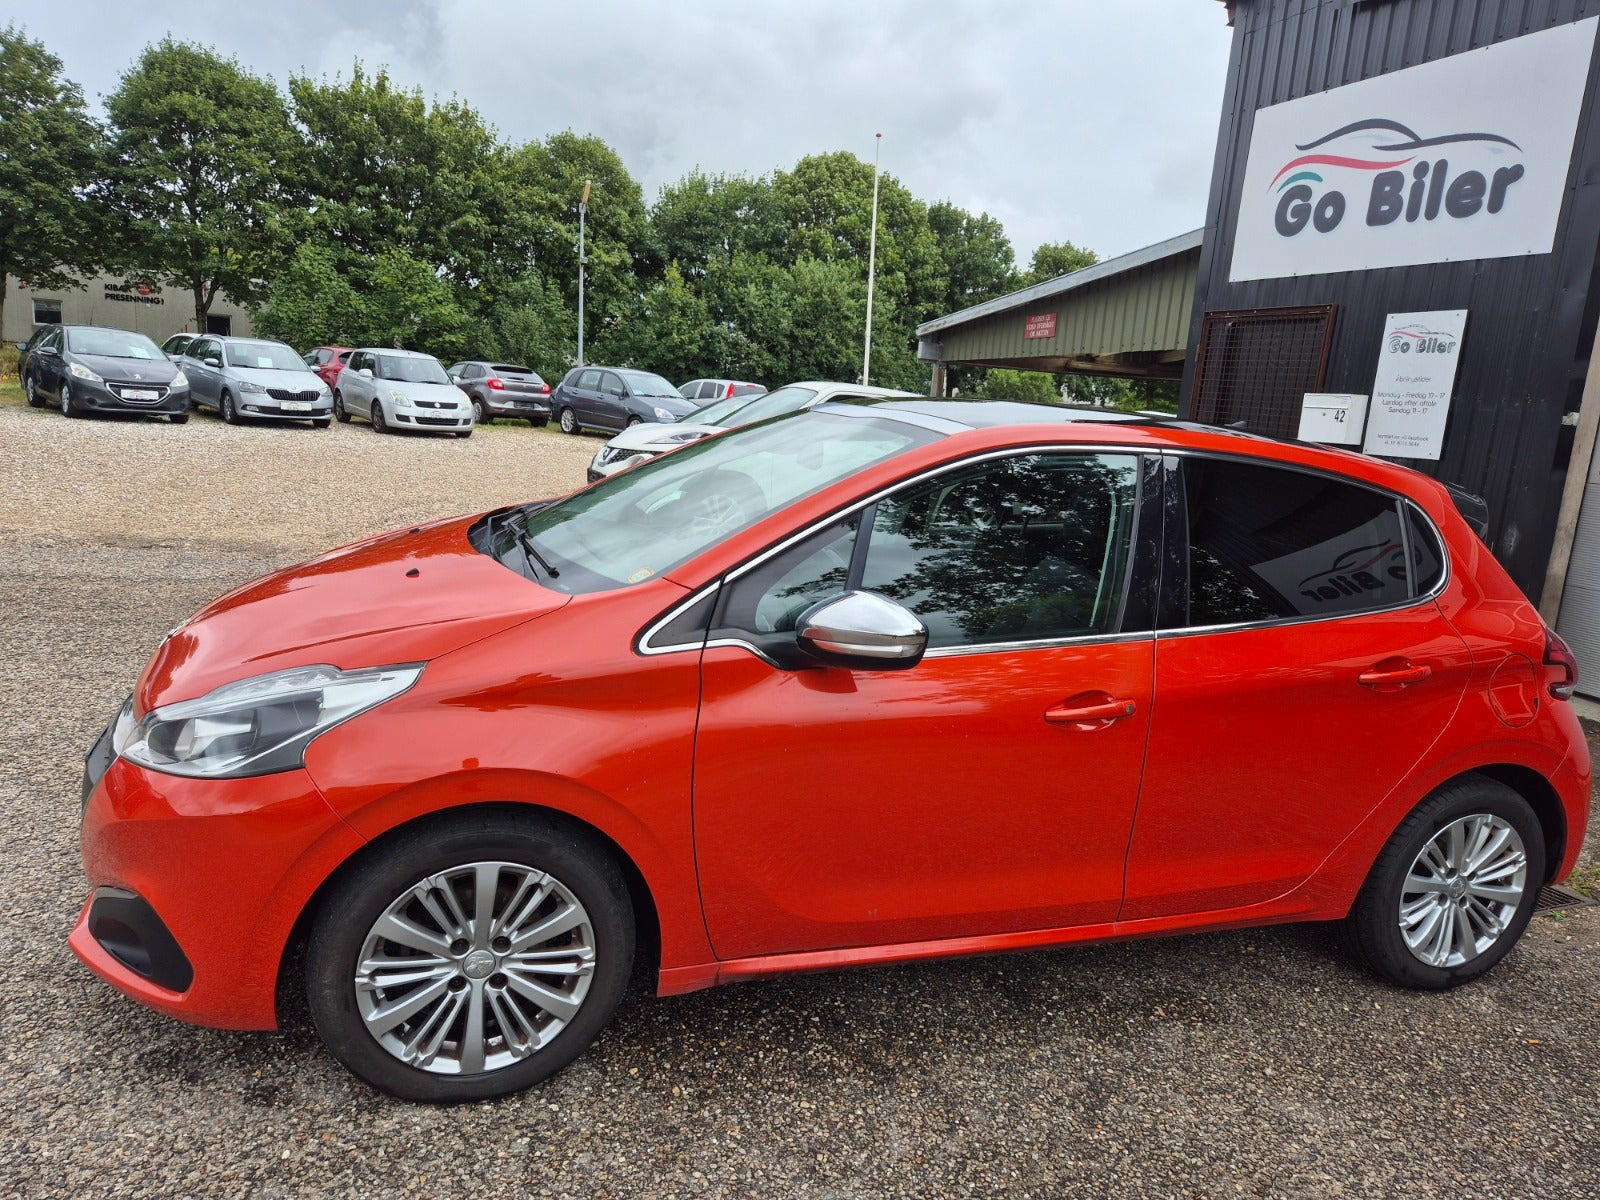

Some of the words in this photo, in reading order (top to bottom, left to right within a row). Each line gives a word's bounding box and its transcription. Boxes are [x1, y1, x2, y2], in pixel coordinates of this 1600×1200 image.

[1275, 185, 1345, 237] Go
[1366, 159, 1524, 226] Biler
[1389, 339, 1410, 353] Go
[1415, 338, 1456, 353] Biler
[1334, 410, 1346, 423] 42
